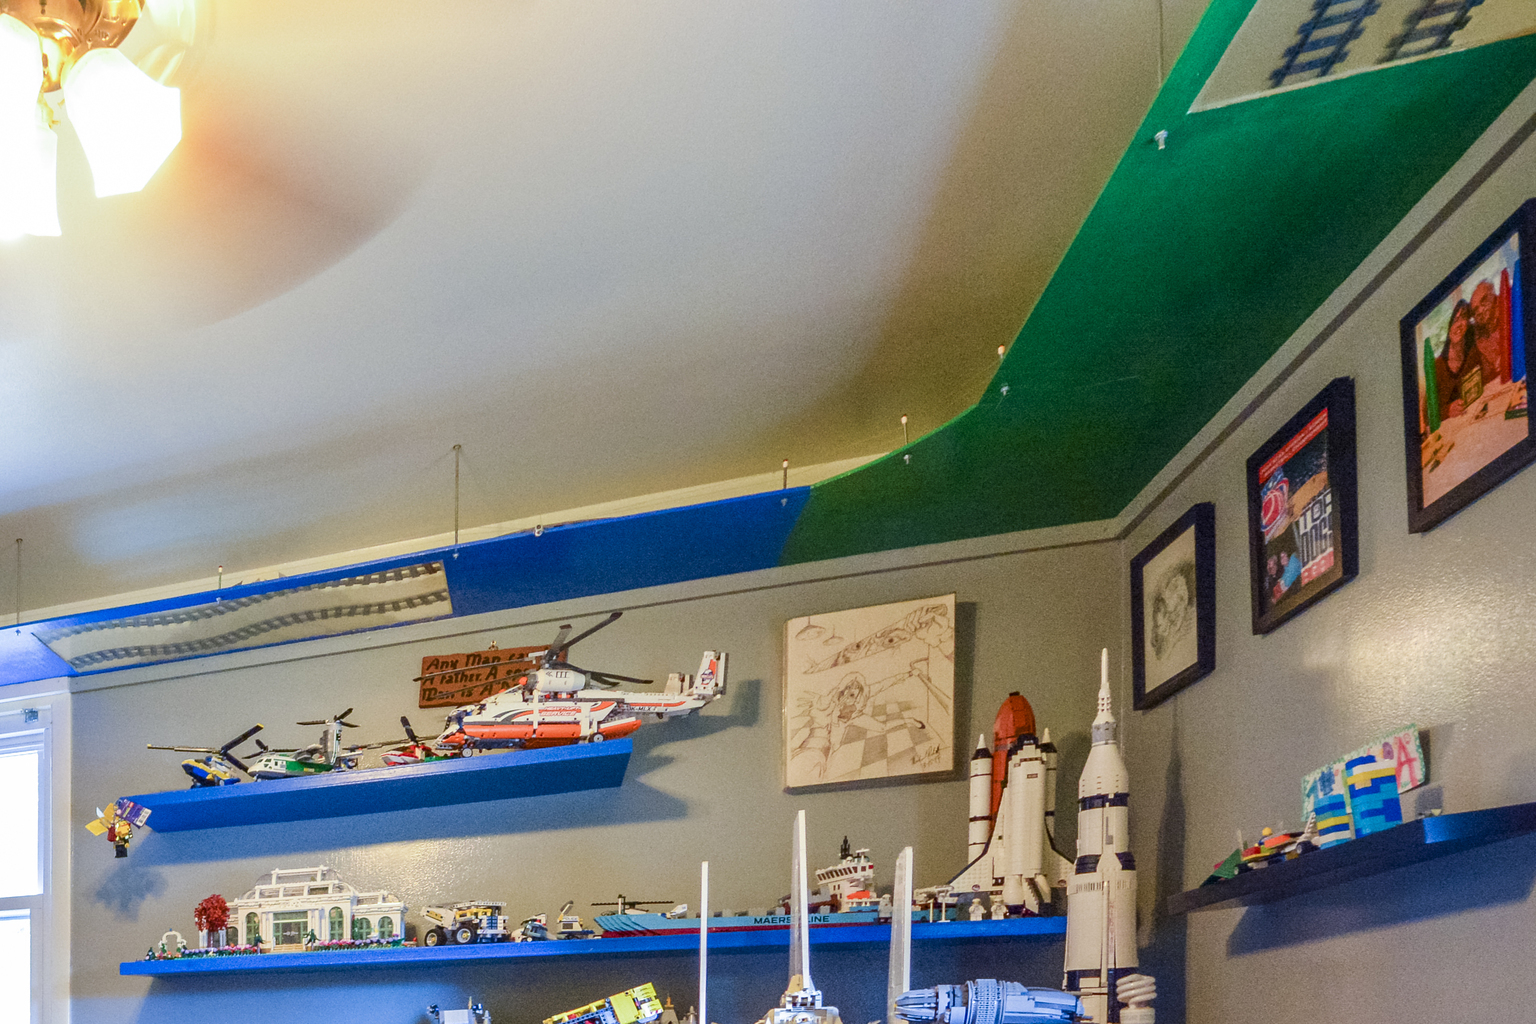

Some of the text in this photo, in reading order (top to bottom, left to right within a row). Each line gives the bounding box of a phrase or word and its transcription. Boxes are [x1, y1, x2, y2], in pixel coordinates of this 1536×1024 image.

[465, 653, 502, 666] Man
[753, 915, 830, 925] MAERS INE
